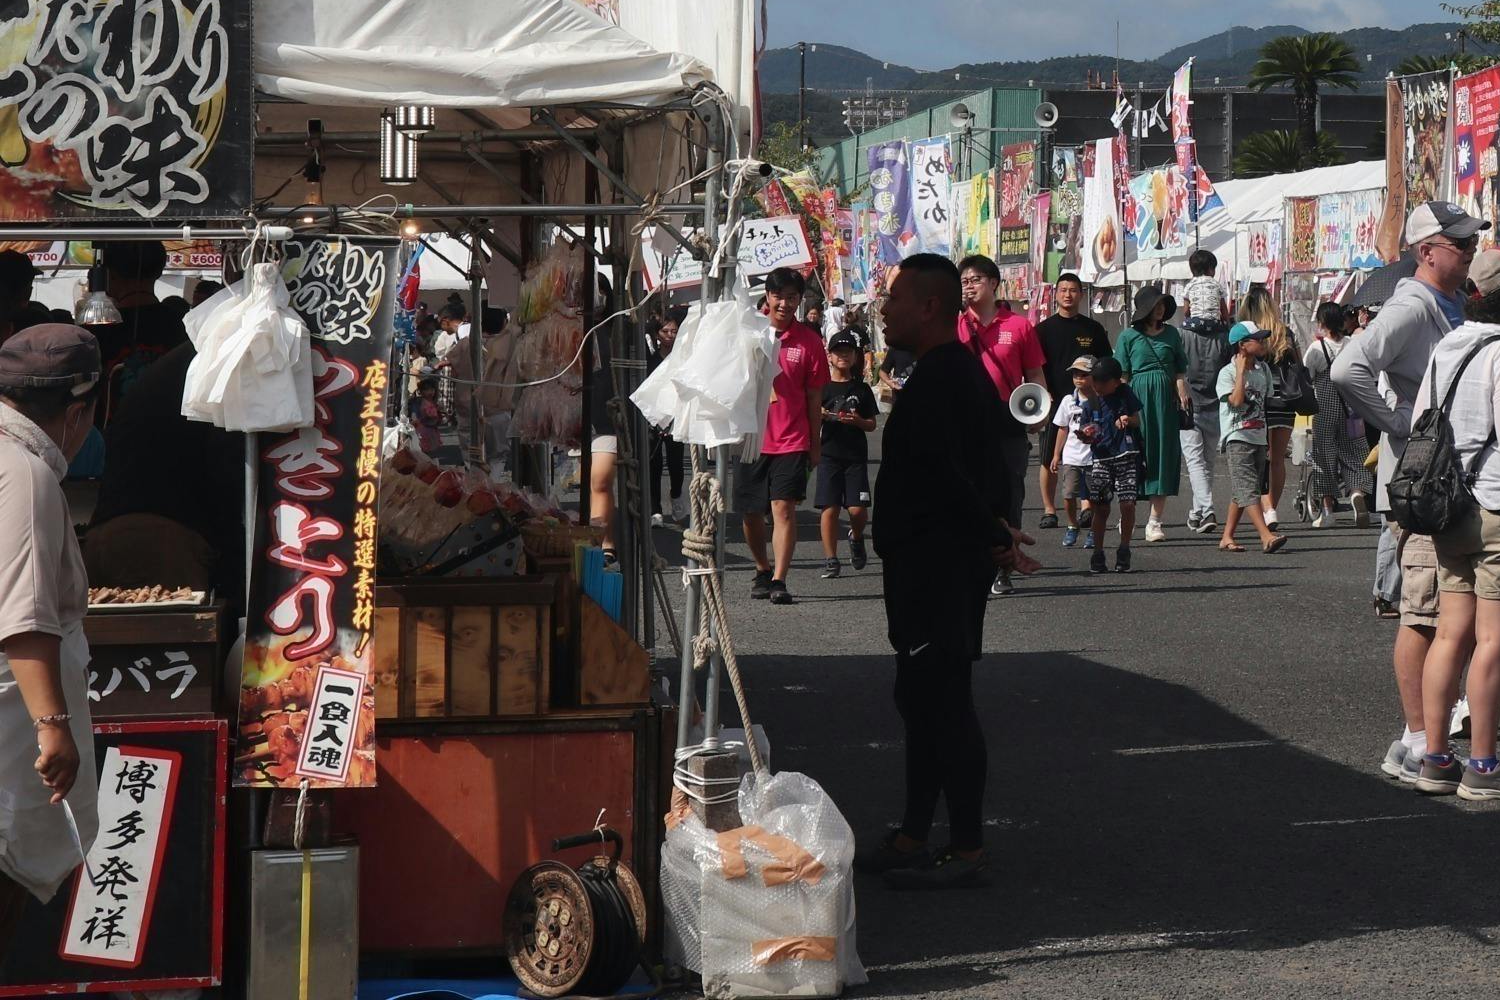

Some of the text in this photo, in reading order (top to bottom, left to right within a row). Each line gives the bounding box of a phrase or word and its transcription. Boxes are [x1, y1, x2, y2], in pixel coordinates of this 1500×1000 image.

[191, 254, 222, 265] ¥600
[351, 359, 388, 659] 店主自慢の特選素材!
[87, 650, 198, 702] バラ
[307, 680, 354, 771] 一食入魂
[79, 760, 159, 950] 博多発祥
